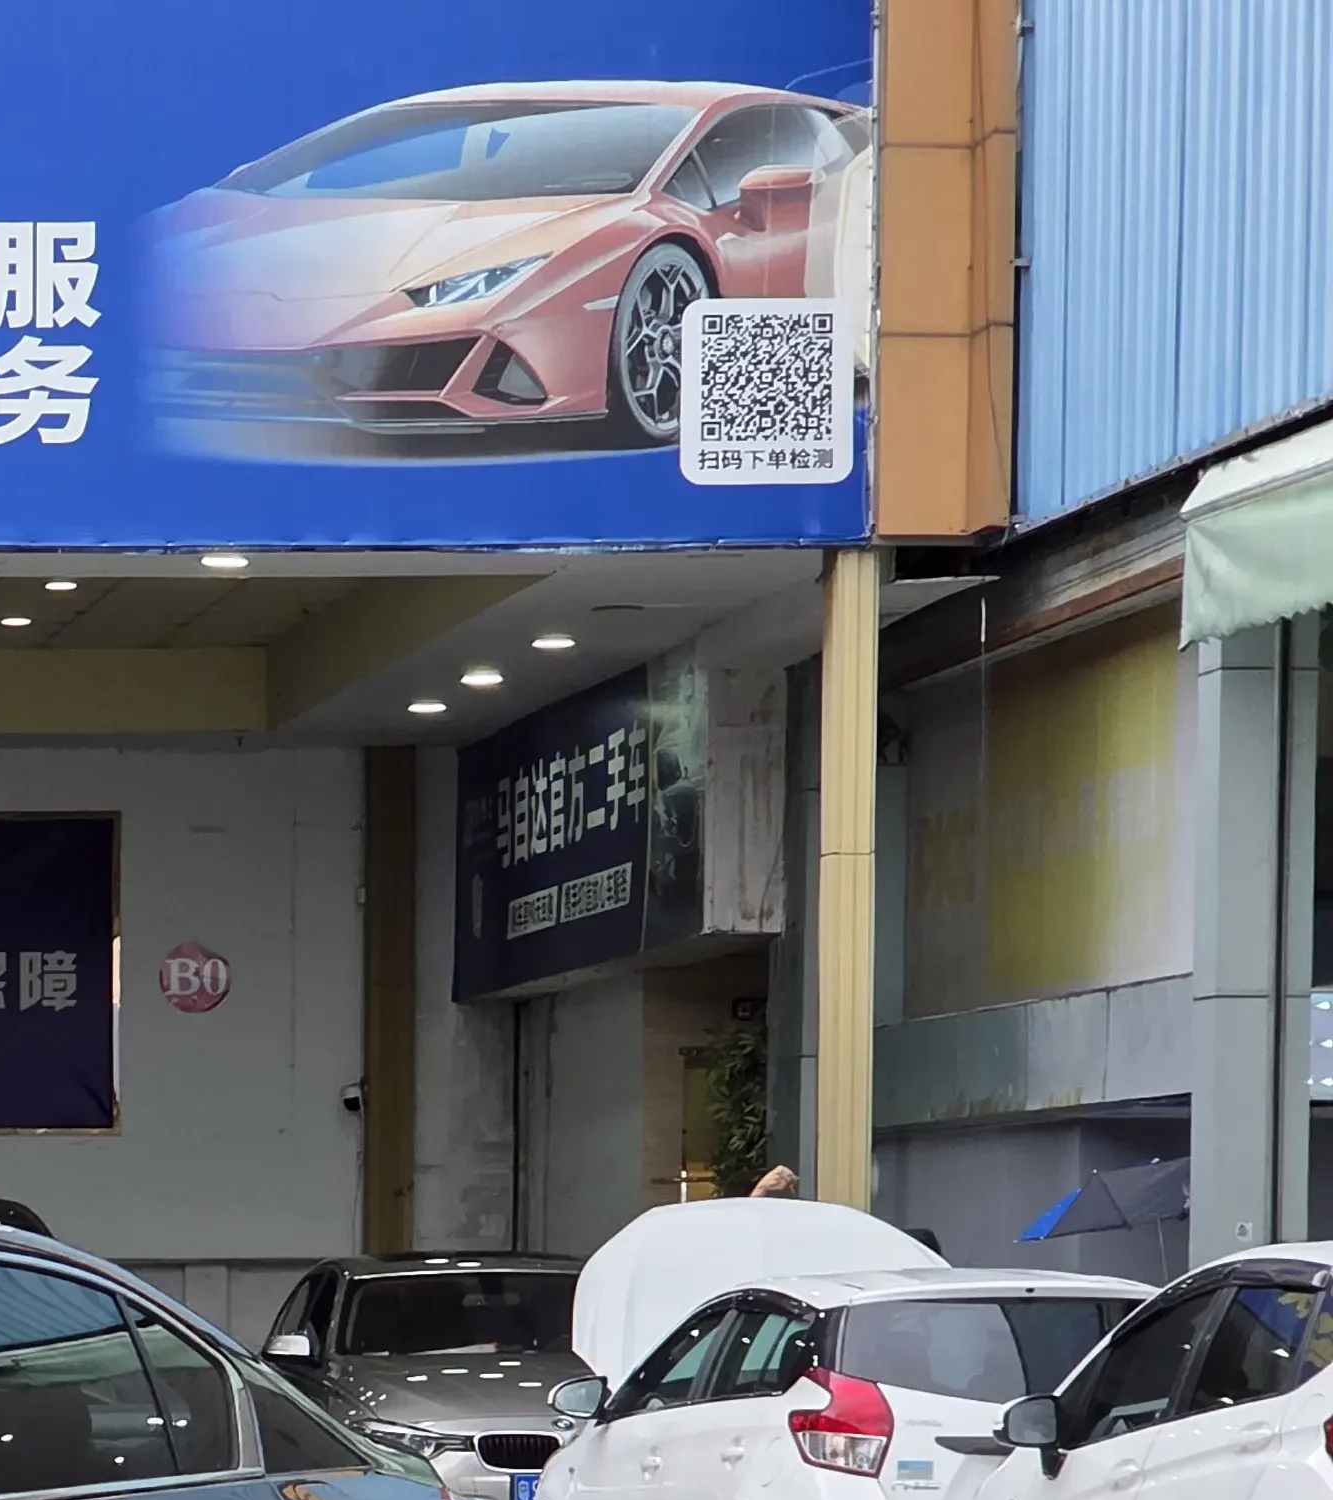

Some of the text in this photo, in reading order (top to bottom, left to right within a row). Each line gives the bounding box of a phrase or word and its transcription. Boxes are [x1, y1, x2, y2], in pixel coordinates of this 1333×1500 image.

[698, 448, 834, 470] 扫码下单检测
[497, 718, 646, 869] 马自达官方二手车
